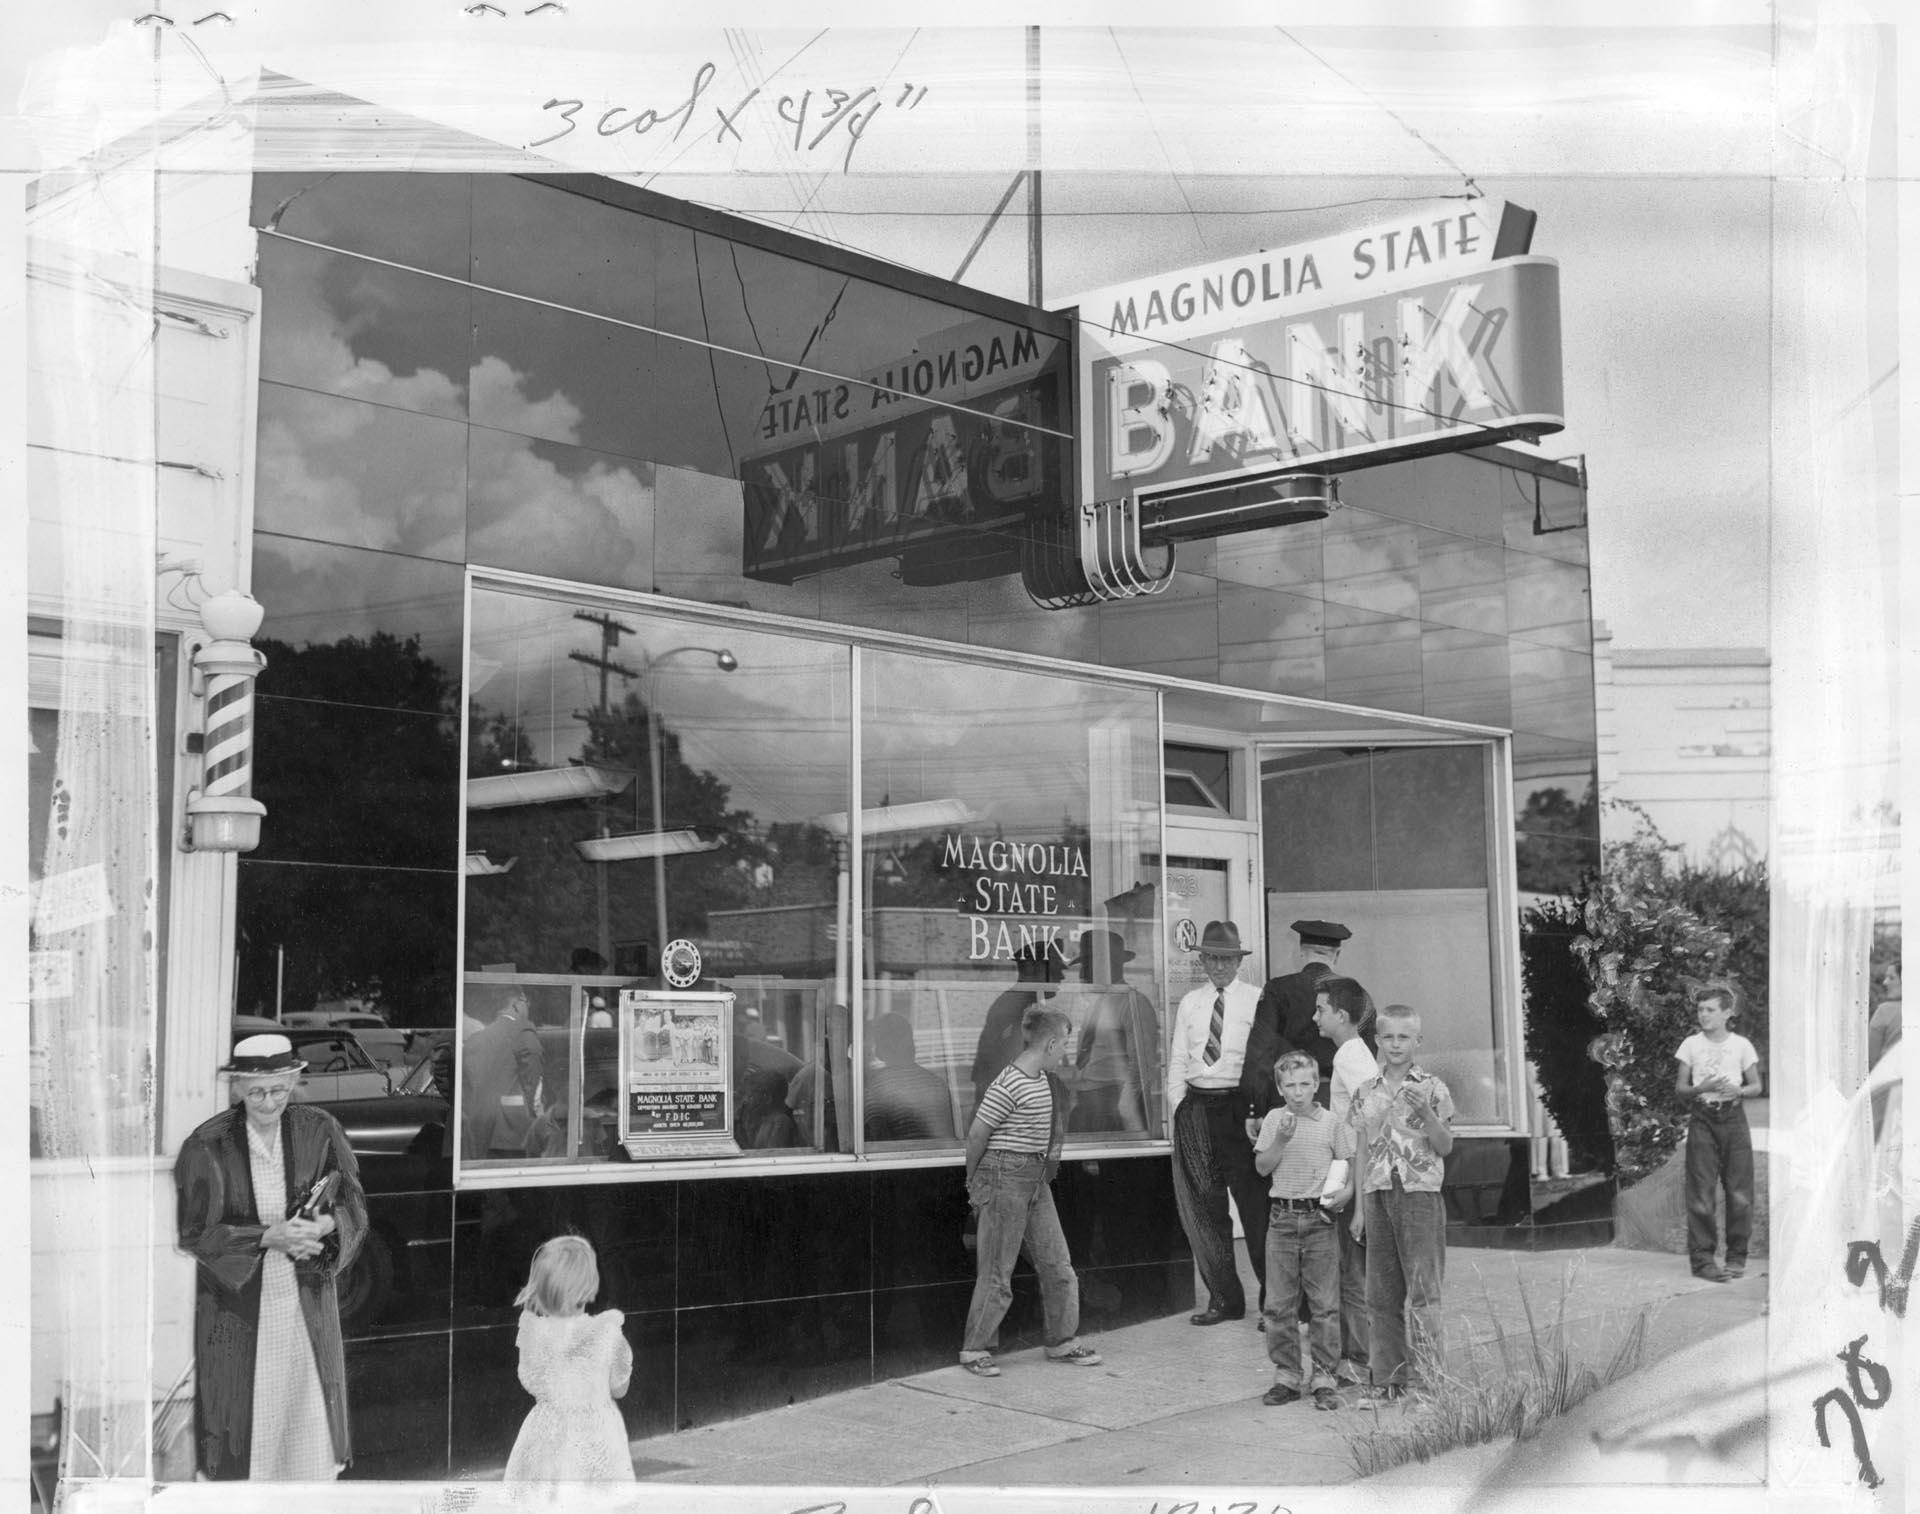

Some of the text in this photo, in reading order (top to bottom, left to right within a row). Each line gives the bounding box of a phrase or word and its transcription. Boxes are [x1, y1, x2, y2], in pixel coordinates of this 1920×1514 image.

[529, 98, 583, 147] 3
[1109, 212, 1481, 338] MAGNOLIA STATE
[1106, 283, 1494, 481] BANK
[941, 834, 1089, 878] MAGNOLIA
[975, 876, 1058, 915] STATE
[968, 915, 1072, 963] BANK
[637, 1094, 718, 1104] MAGNOLIA STATE BANK
